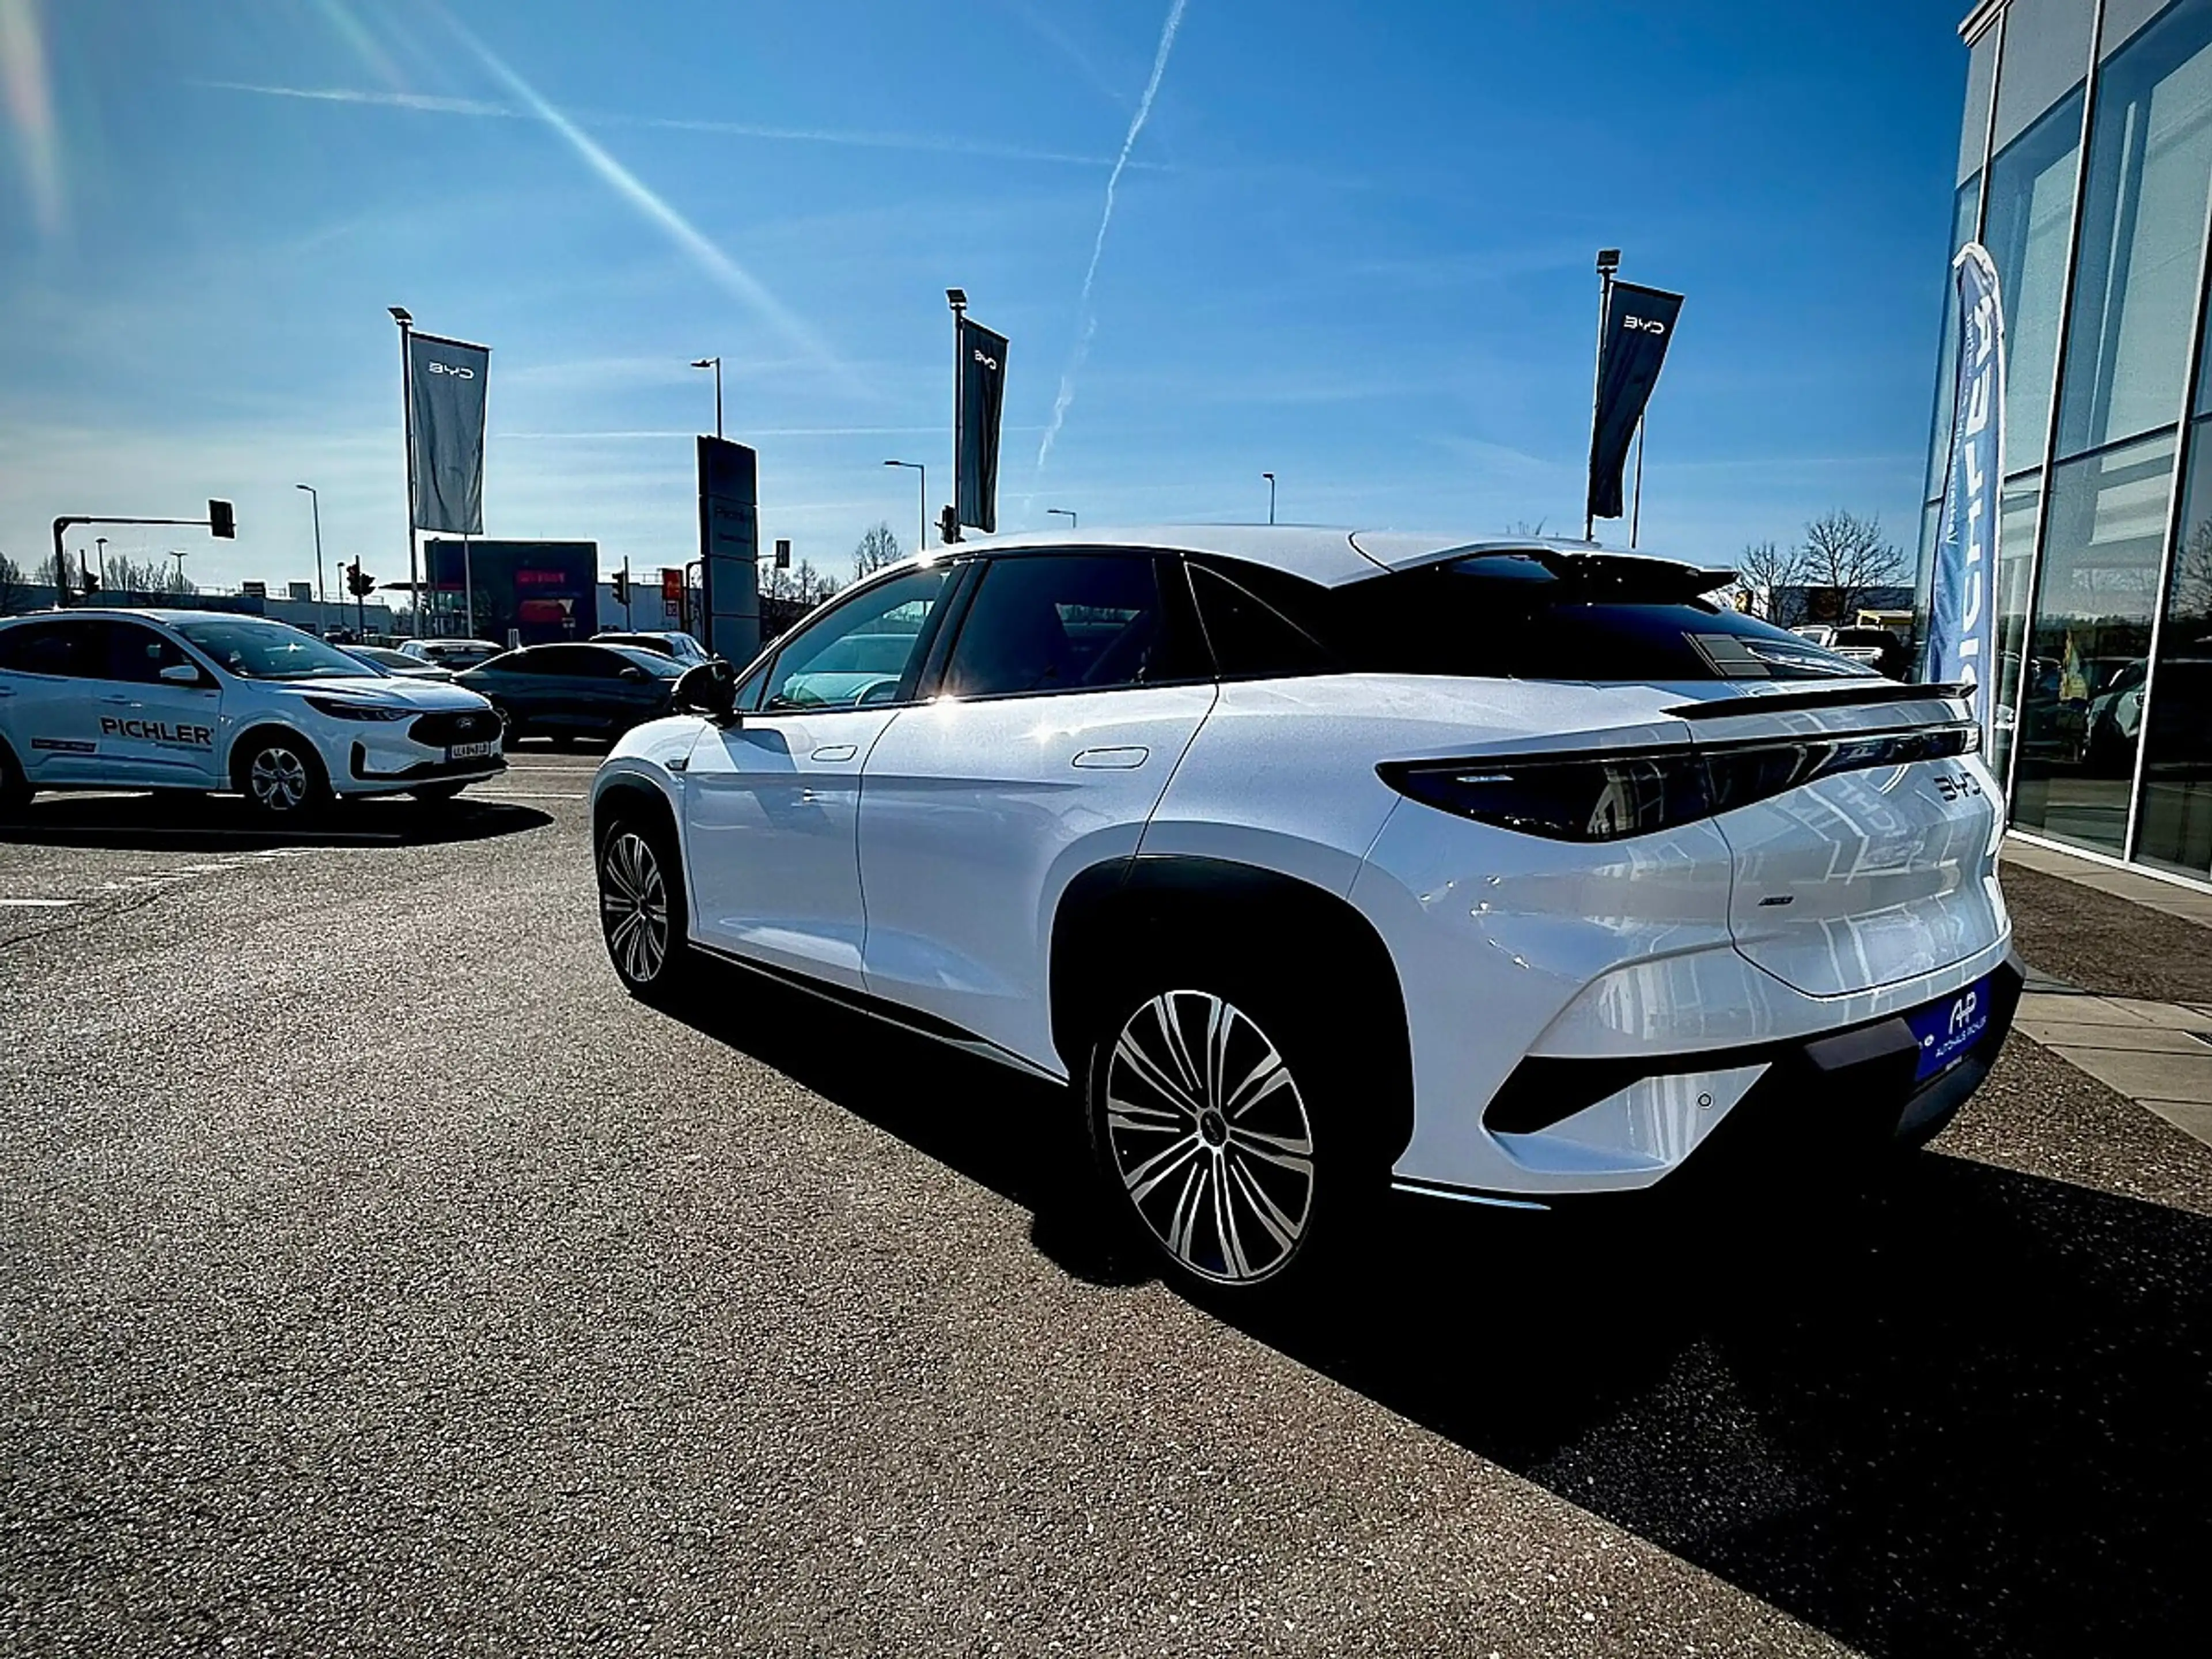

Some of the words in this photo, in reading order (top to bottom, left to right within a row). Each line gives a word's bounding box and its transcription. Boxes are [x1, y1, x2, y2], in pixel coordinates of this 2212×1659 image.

[1624, 315, 1664, 334] BYD
[975, 350, 997, 369] BYD
[429, 362, 474, 379] BYD
[1933, 772, 1980, 802] BYD
